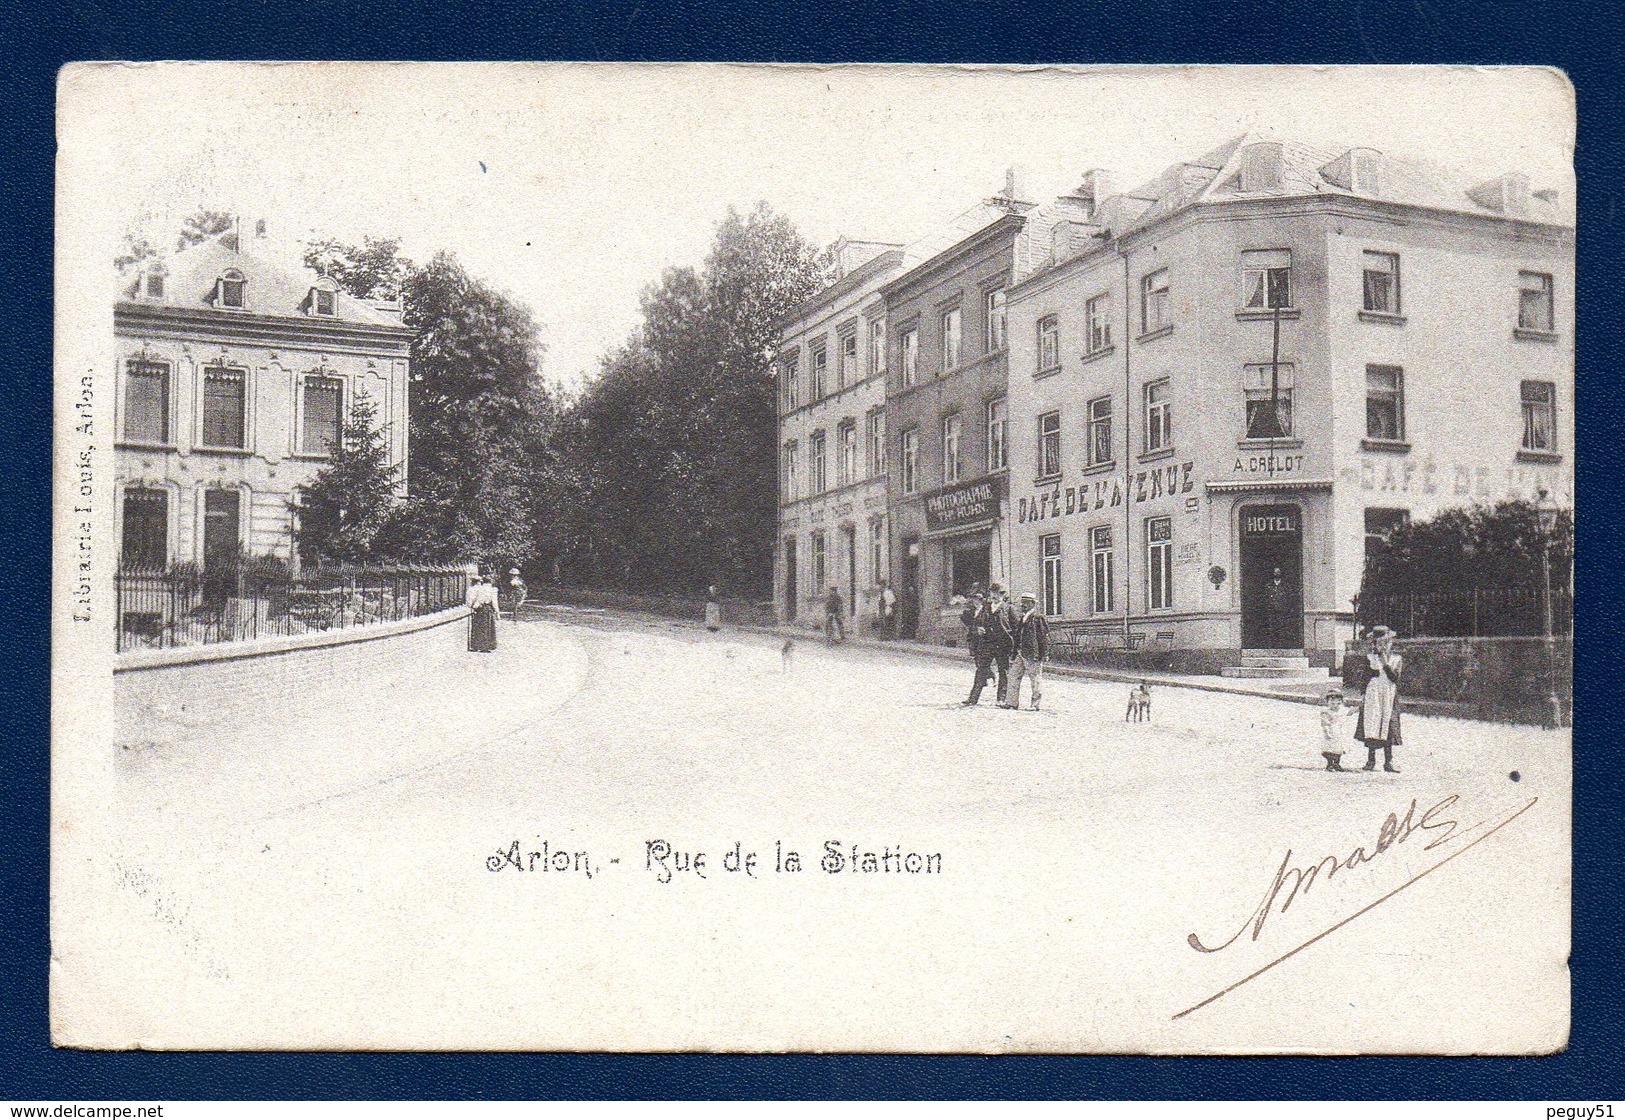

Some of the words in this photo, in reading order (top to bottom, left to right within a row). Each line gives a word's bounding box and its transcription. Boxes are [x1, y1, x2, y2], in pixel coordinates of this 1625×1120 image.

[75, 368, 94, 436] Arlon.
[74, 445, 97, 514] Louis,
[927, 483, 993, 512] PHOTOGRAPHIE
[1065, 484, 1089, 515] DE
[1094, 461, 1194, 511] L'AVENUE
[1247, 516, 1296, 532] HOTEL
[72, 522, 92, 623] Librairie
[645, 839, 708, 884] Rue
[723, 841, 759, 880] de
[775, 841, 803, 874] la
[820, 840, 943, 875] Station
